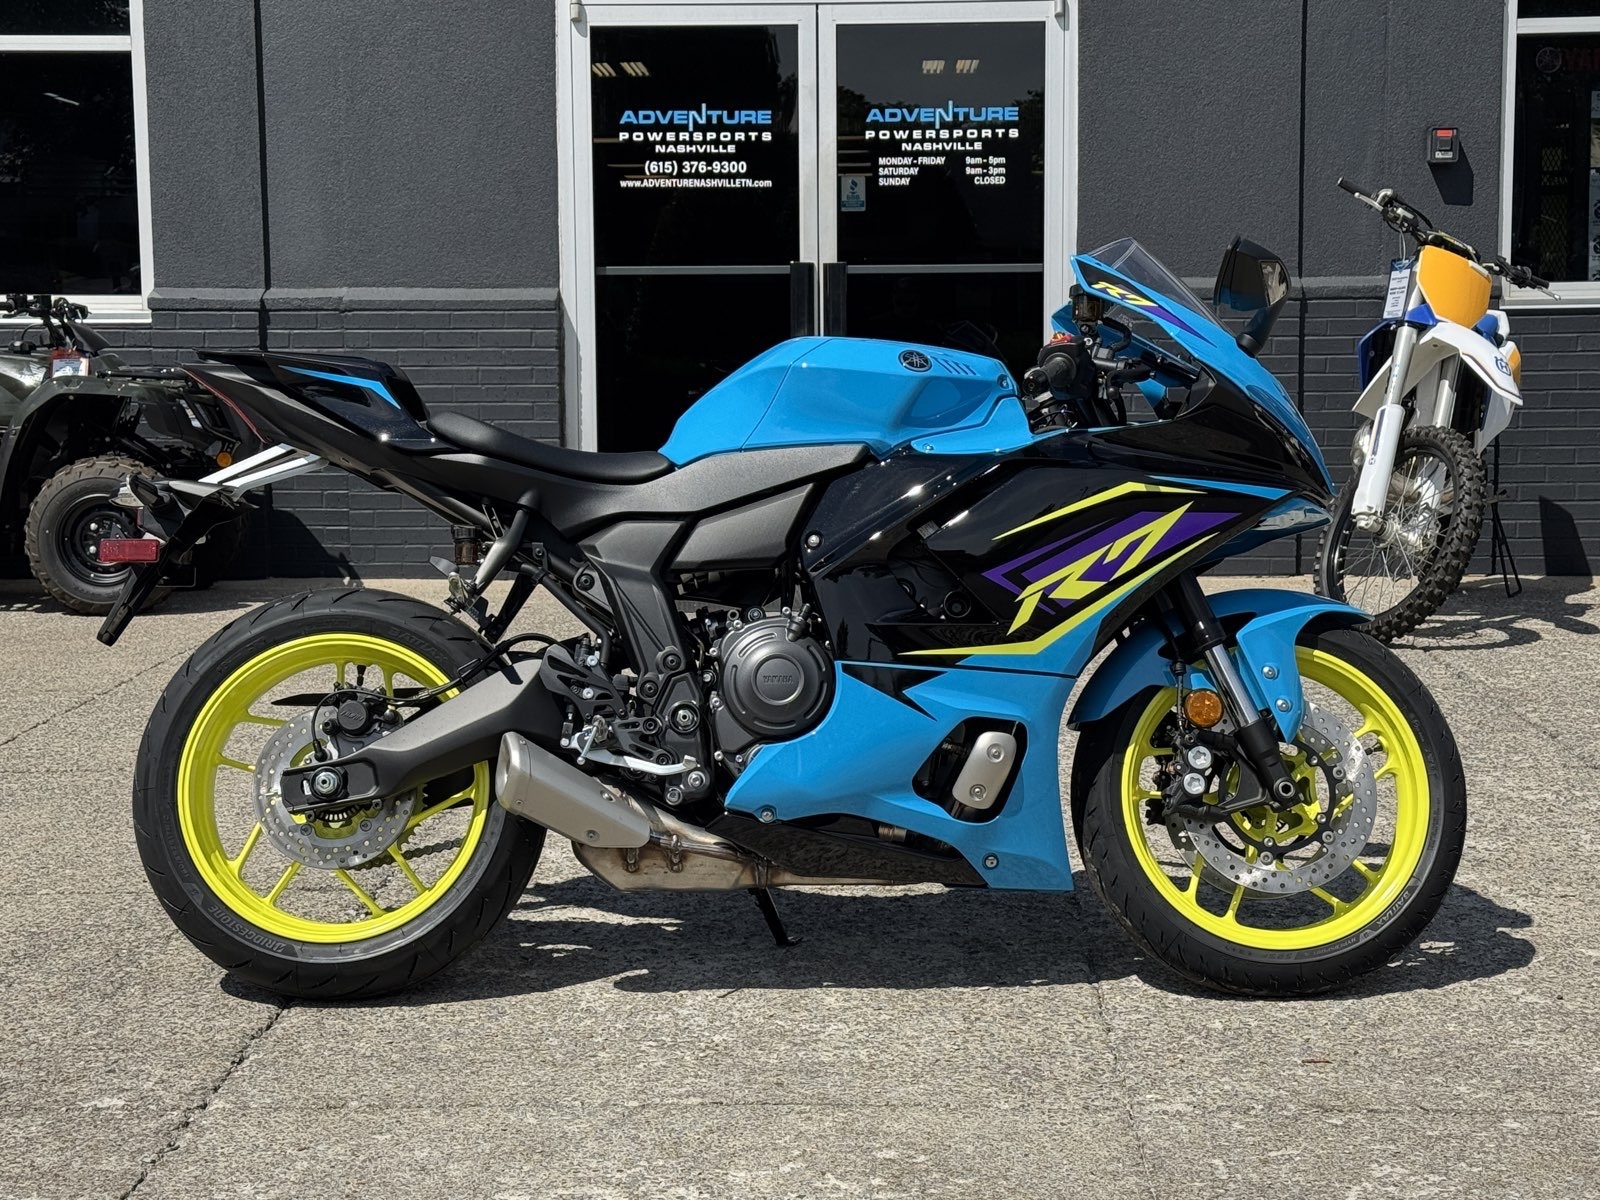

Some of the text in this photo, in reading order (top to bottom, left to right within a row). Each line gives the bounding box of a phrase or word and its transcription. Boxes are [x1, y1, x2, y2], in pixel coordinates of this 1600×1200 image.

[619, 103, 772, 131] ADVENTURE
[866, 101, 1019, 129] ADVENTURE
[619, 132, 772, 141] POWERSPORTS
[865, 129, 1019, 140] POWERSPORTS
[655, 145, 736, 153] NASHVILLE
[902, 142, 982, 150] NASHVILLE
[878, 157, 913, 165] MONDAY
[918, 157, 945, 165] FRIDAY
[965, 156, 982, 164] 9am
[644, 161, 747, 175] (615) 376-9300
[878, 167, 919, 175] SATURDAY
[988, 167, 1006, 175] 3pm
[620, 179, 772, 188] www.ADVENTURENASHVILLETN.com
[974, 176, 1006, 184] CLOSED
[1007, 501, 1194, 636] R7
[763, 675, 792, 684] YAMAHA
[1375, 889, 1411, 927] BATTLAX
[206, 902, 286, 954] BRIDGESTONE
